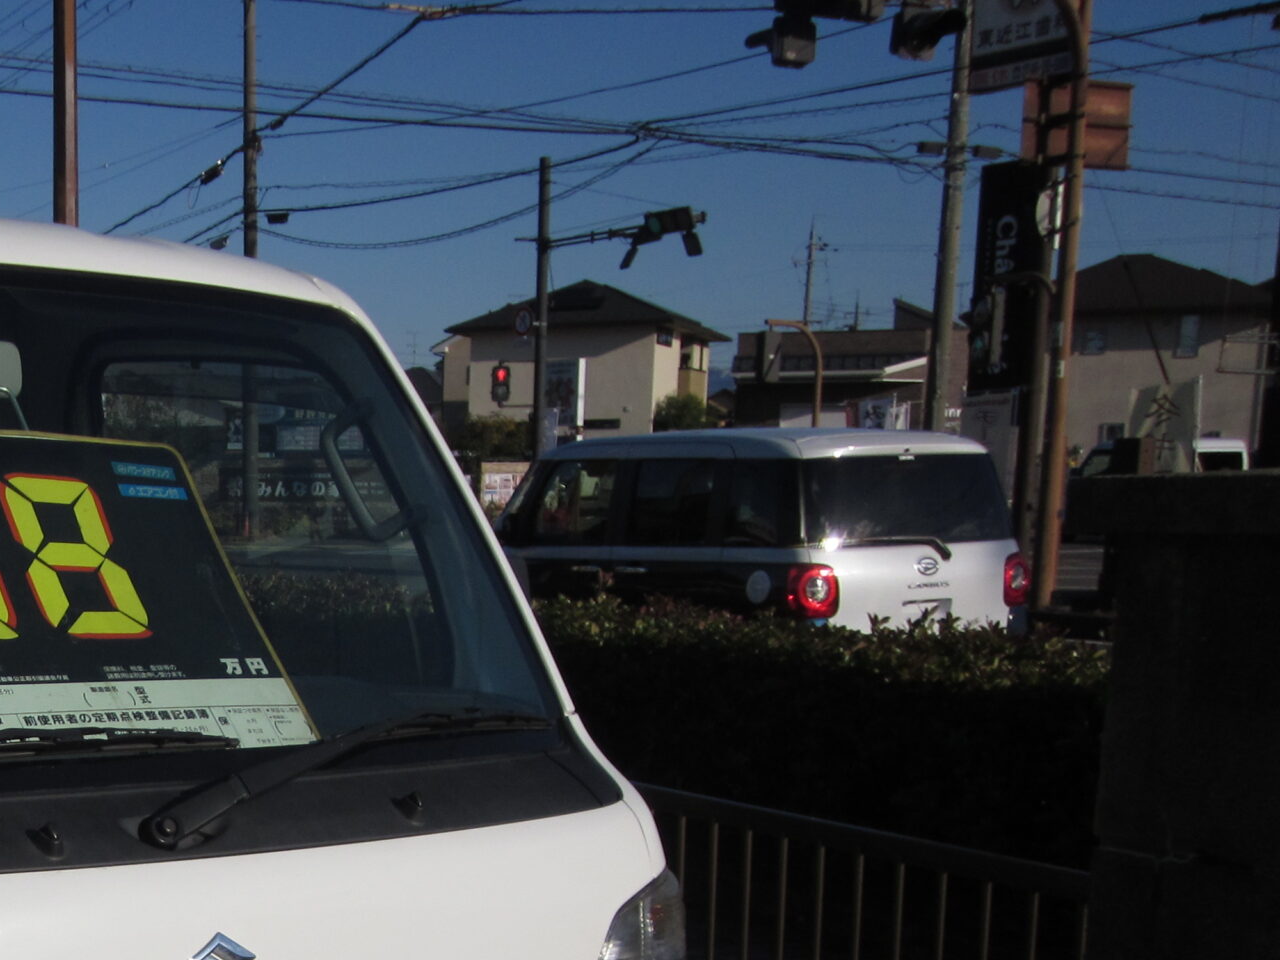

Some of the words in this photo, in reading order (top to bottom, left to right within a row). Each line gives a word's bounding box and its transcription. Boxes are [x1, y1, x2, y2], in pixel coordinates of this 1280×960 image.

[22, 708, 210, 727] 前使用者の定期点検整備記録簿
